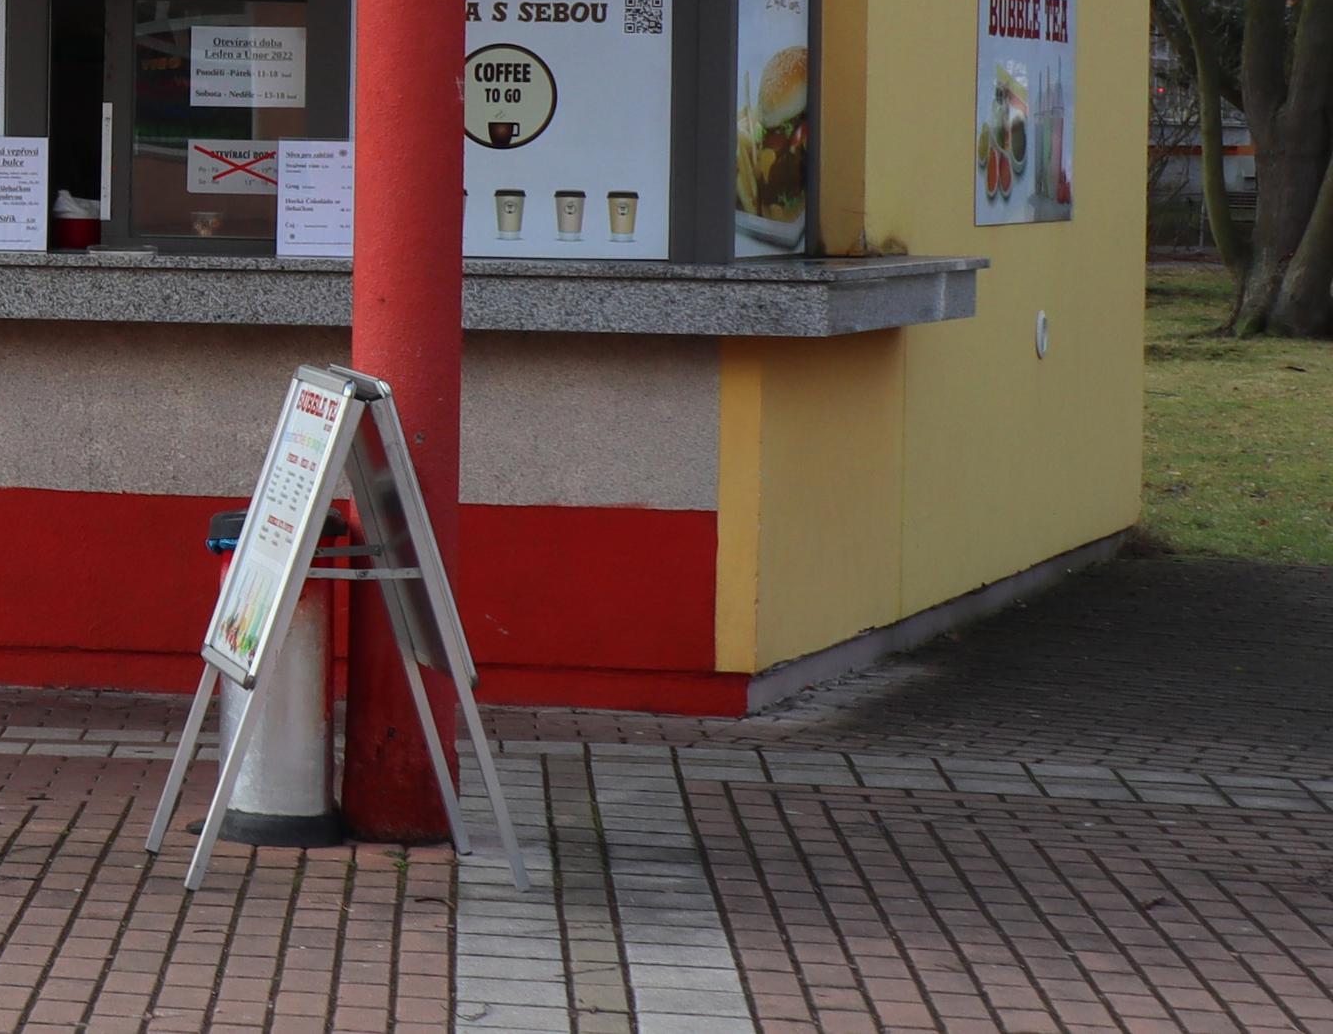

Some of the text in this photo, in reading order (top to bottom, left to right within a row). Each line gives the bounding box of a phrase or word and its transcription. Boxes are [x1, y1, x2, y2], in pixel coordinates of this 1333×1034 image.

[492, 2, 508, 22] S
[518, 2, 608, 23] SEBOU
[474, 63, 531, 82] COFFEE
[485, 88, 521, 103] TO GO
